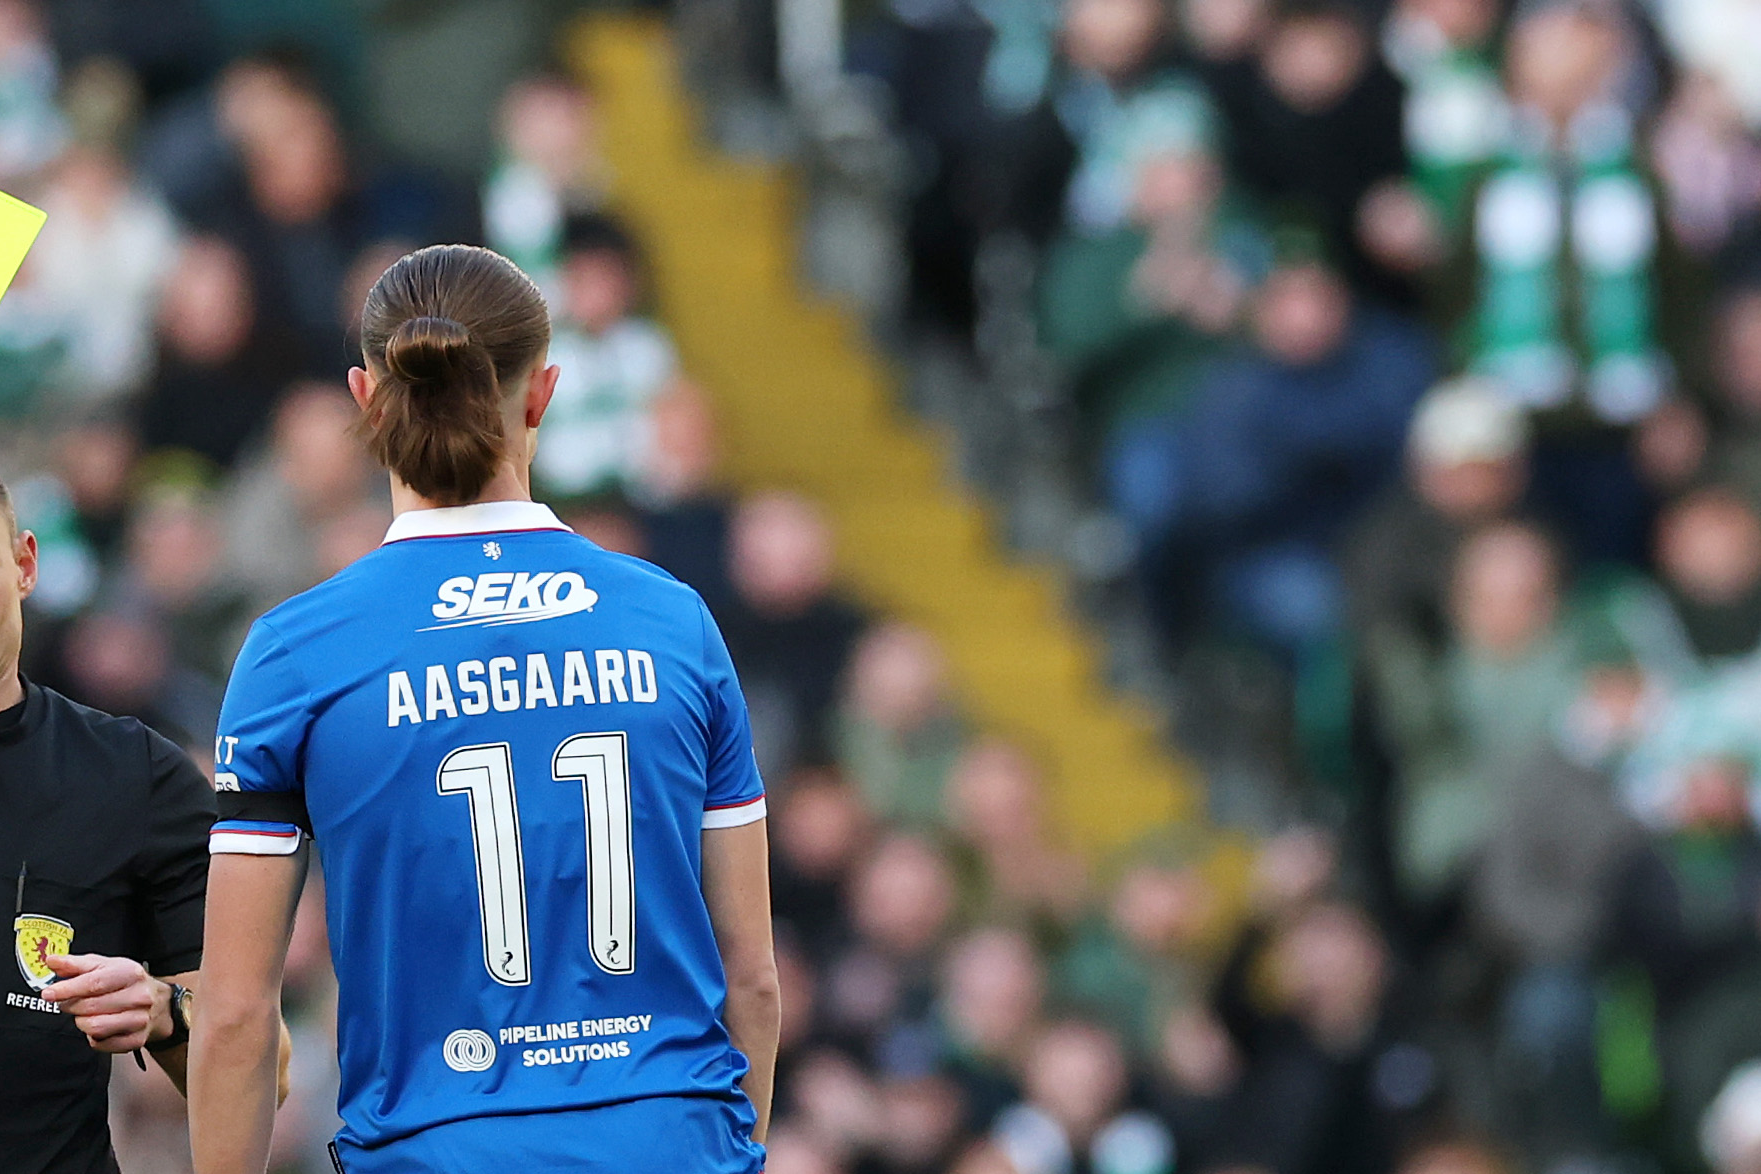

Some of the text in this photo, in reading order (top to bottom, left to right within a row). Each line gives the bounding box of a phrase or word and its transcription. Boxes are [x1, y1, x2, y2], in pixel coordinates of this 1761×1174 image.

[431, 571, 588, 619] SEKO
[388, 649, 658, 727] AASGAARD
[436, 731, 636, 987] 11
[499, 1014, 652, 1045] PIPELINE ENERGY
[522, 1040, 630, 1067] SOLUTIONS
